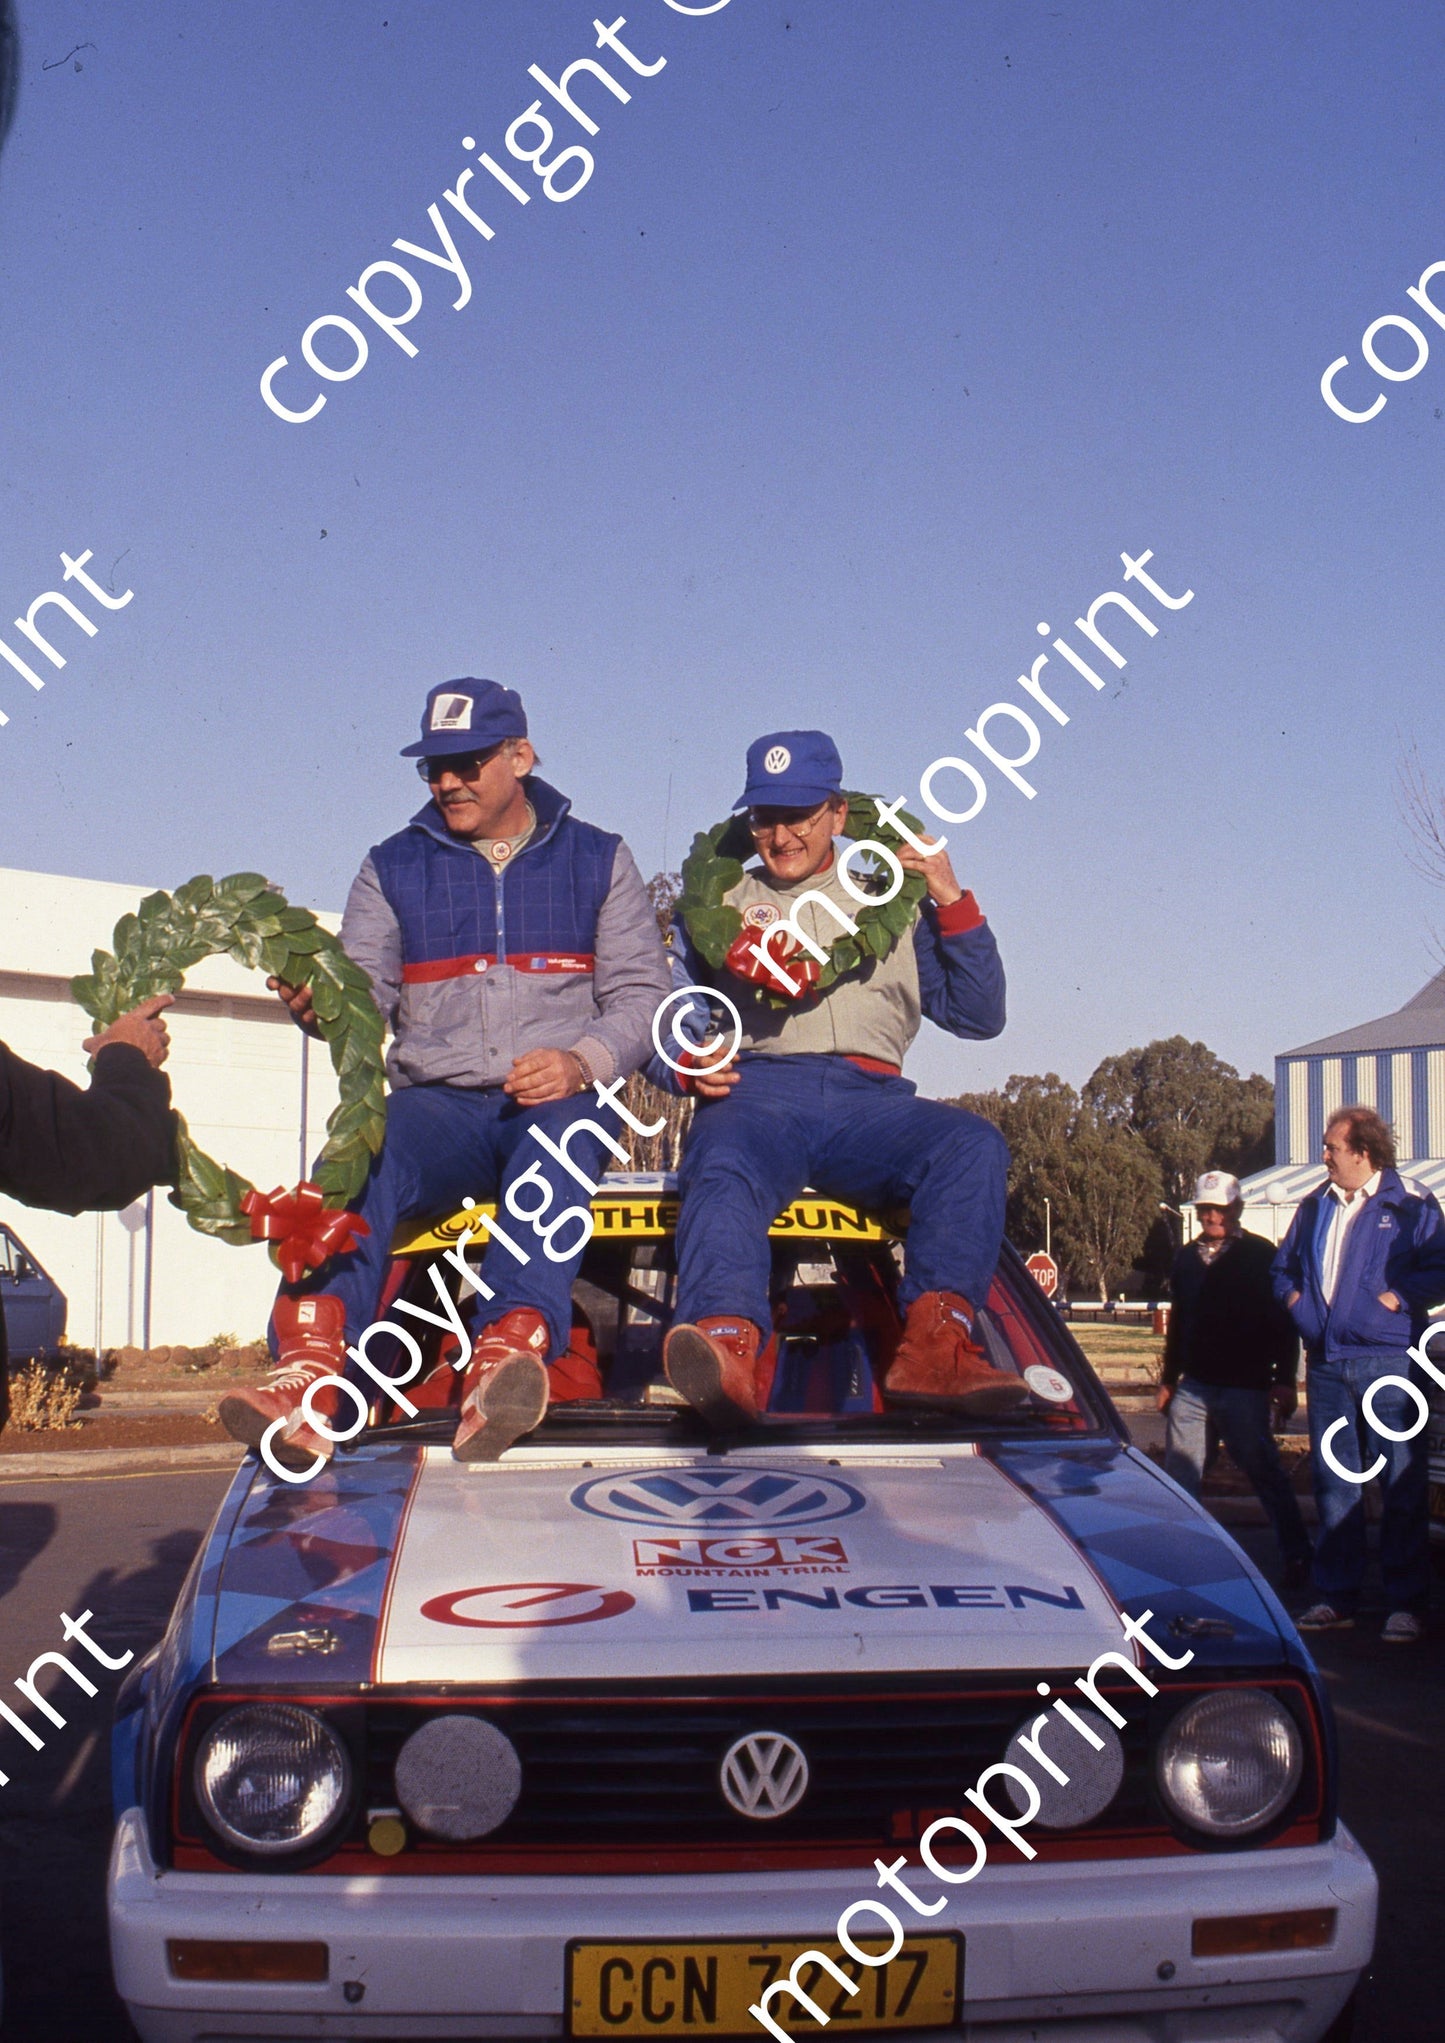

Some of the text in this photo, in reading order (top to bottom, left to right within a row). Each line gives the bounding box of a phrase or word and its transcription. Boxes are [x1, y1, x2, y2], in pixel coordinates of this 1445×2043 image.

[1030, 1269, 1055, 1286] TOP
[635, 1538, 846, 1565] NGK
[636, 1565, 849, 1577] MOUNTAIN TRIAL
[687, 1585, 1086, 1611] ENGEN
[600, 1957, 718, 2024] CCN
